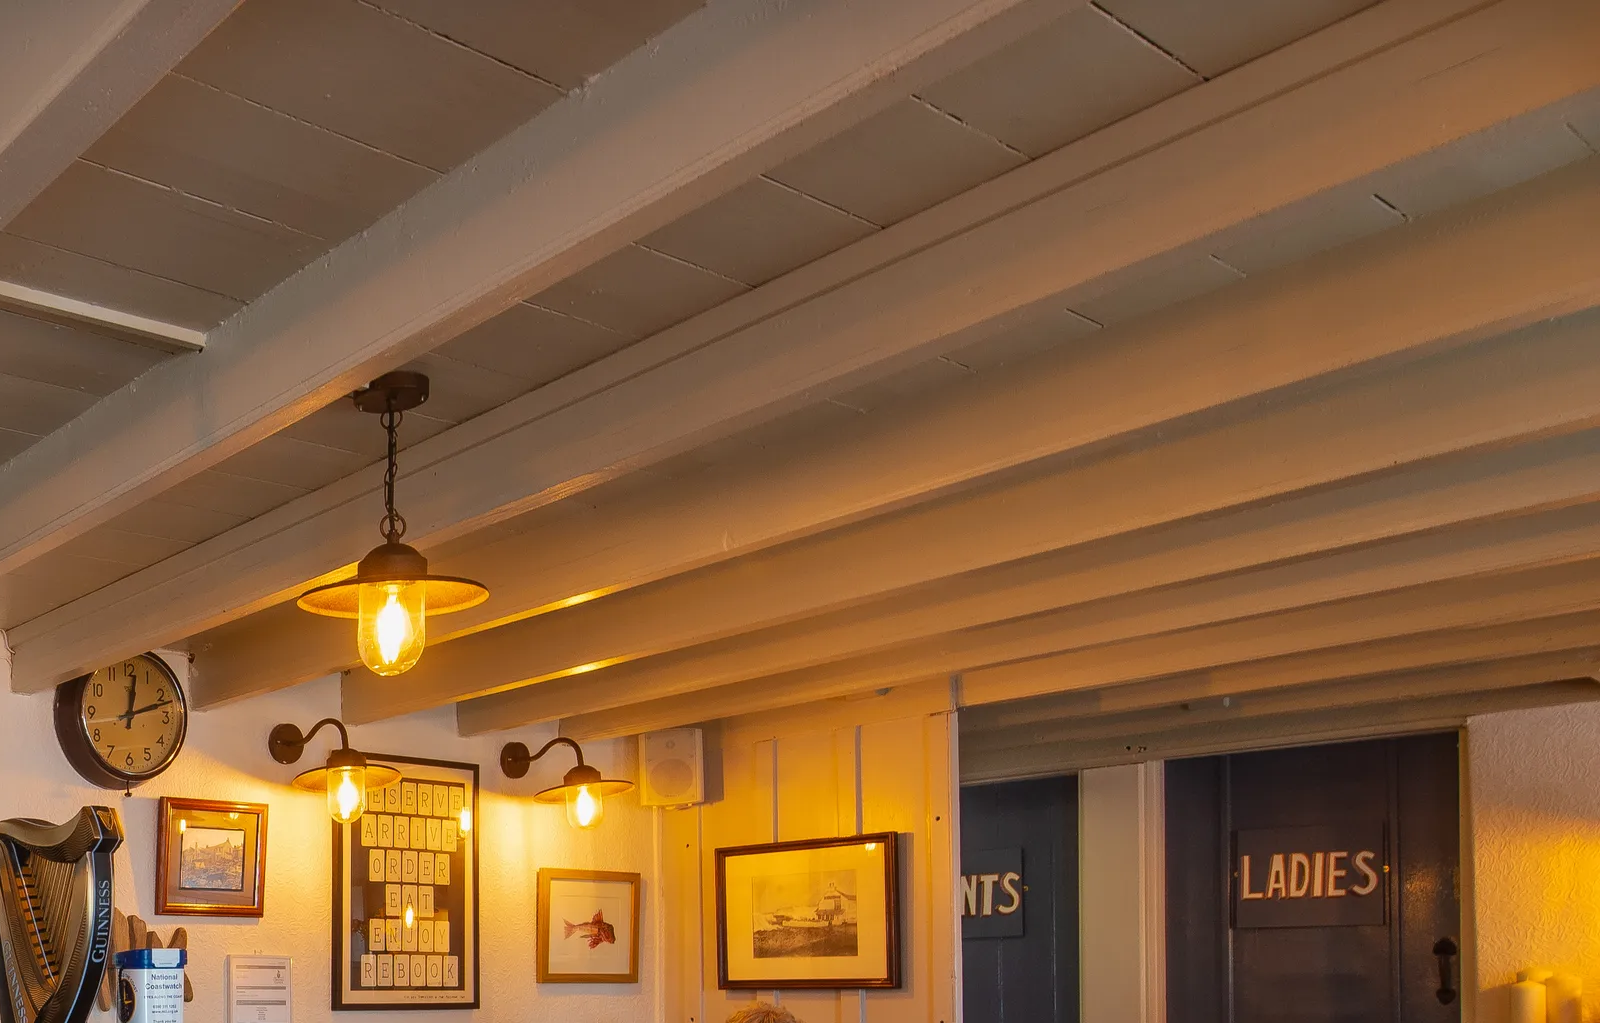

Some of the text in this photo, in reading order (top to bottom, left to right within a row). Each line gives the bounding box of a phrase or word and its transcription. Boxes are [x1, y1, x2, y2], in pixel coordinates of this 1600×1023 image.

[108, 666, 116, 682] 11
[123, 662, 135, 677] 12
[145, 670, 149, 685] 1
[92, 682, 103, 698] 10
[156, 688, 165, 702] 2
[87, 705, 96, 719] 9
[161, 710, 170, 725] 3
[93, 728, 101, 742] 8
[155, 733, 165, 748] 4
[106, 744, 115, 759] 7
[125, 752, 134, 766] 6
[143, 747, 152, 762] 5
[372, 788, 461, 810] ESERVE
[364, 823, 453, 845] ARRIVE
[372, 857, 447, 878] ORDER
[1240, 850, 1379, 901] LADIES
[390, 892, 430, 910] EAT
[960, 871, 1020, 917] NTS
[91, 879, 110, 963] GUINNESS
[373, 927, 447, 945] ENJOY
[151, 973, 178, 981] National
[364, 962, 454, 979] REBOOK
[145, 982, 183, 990] Coastwatch
